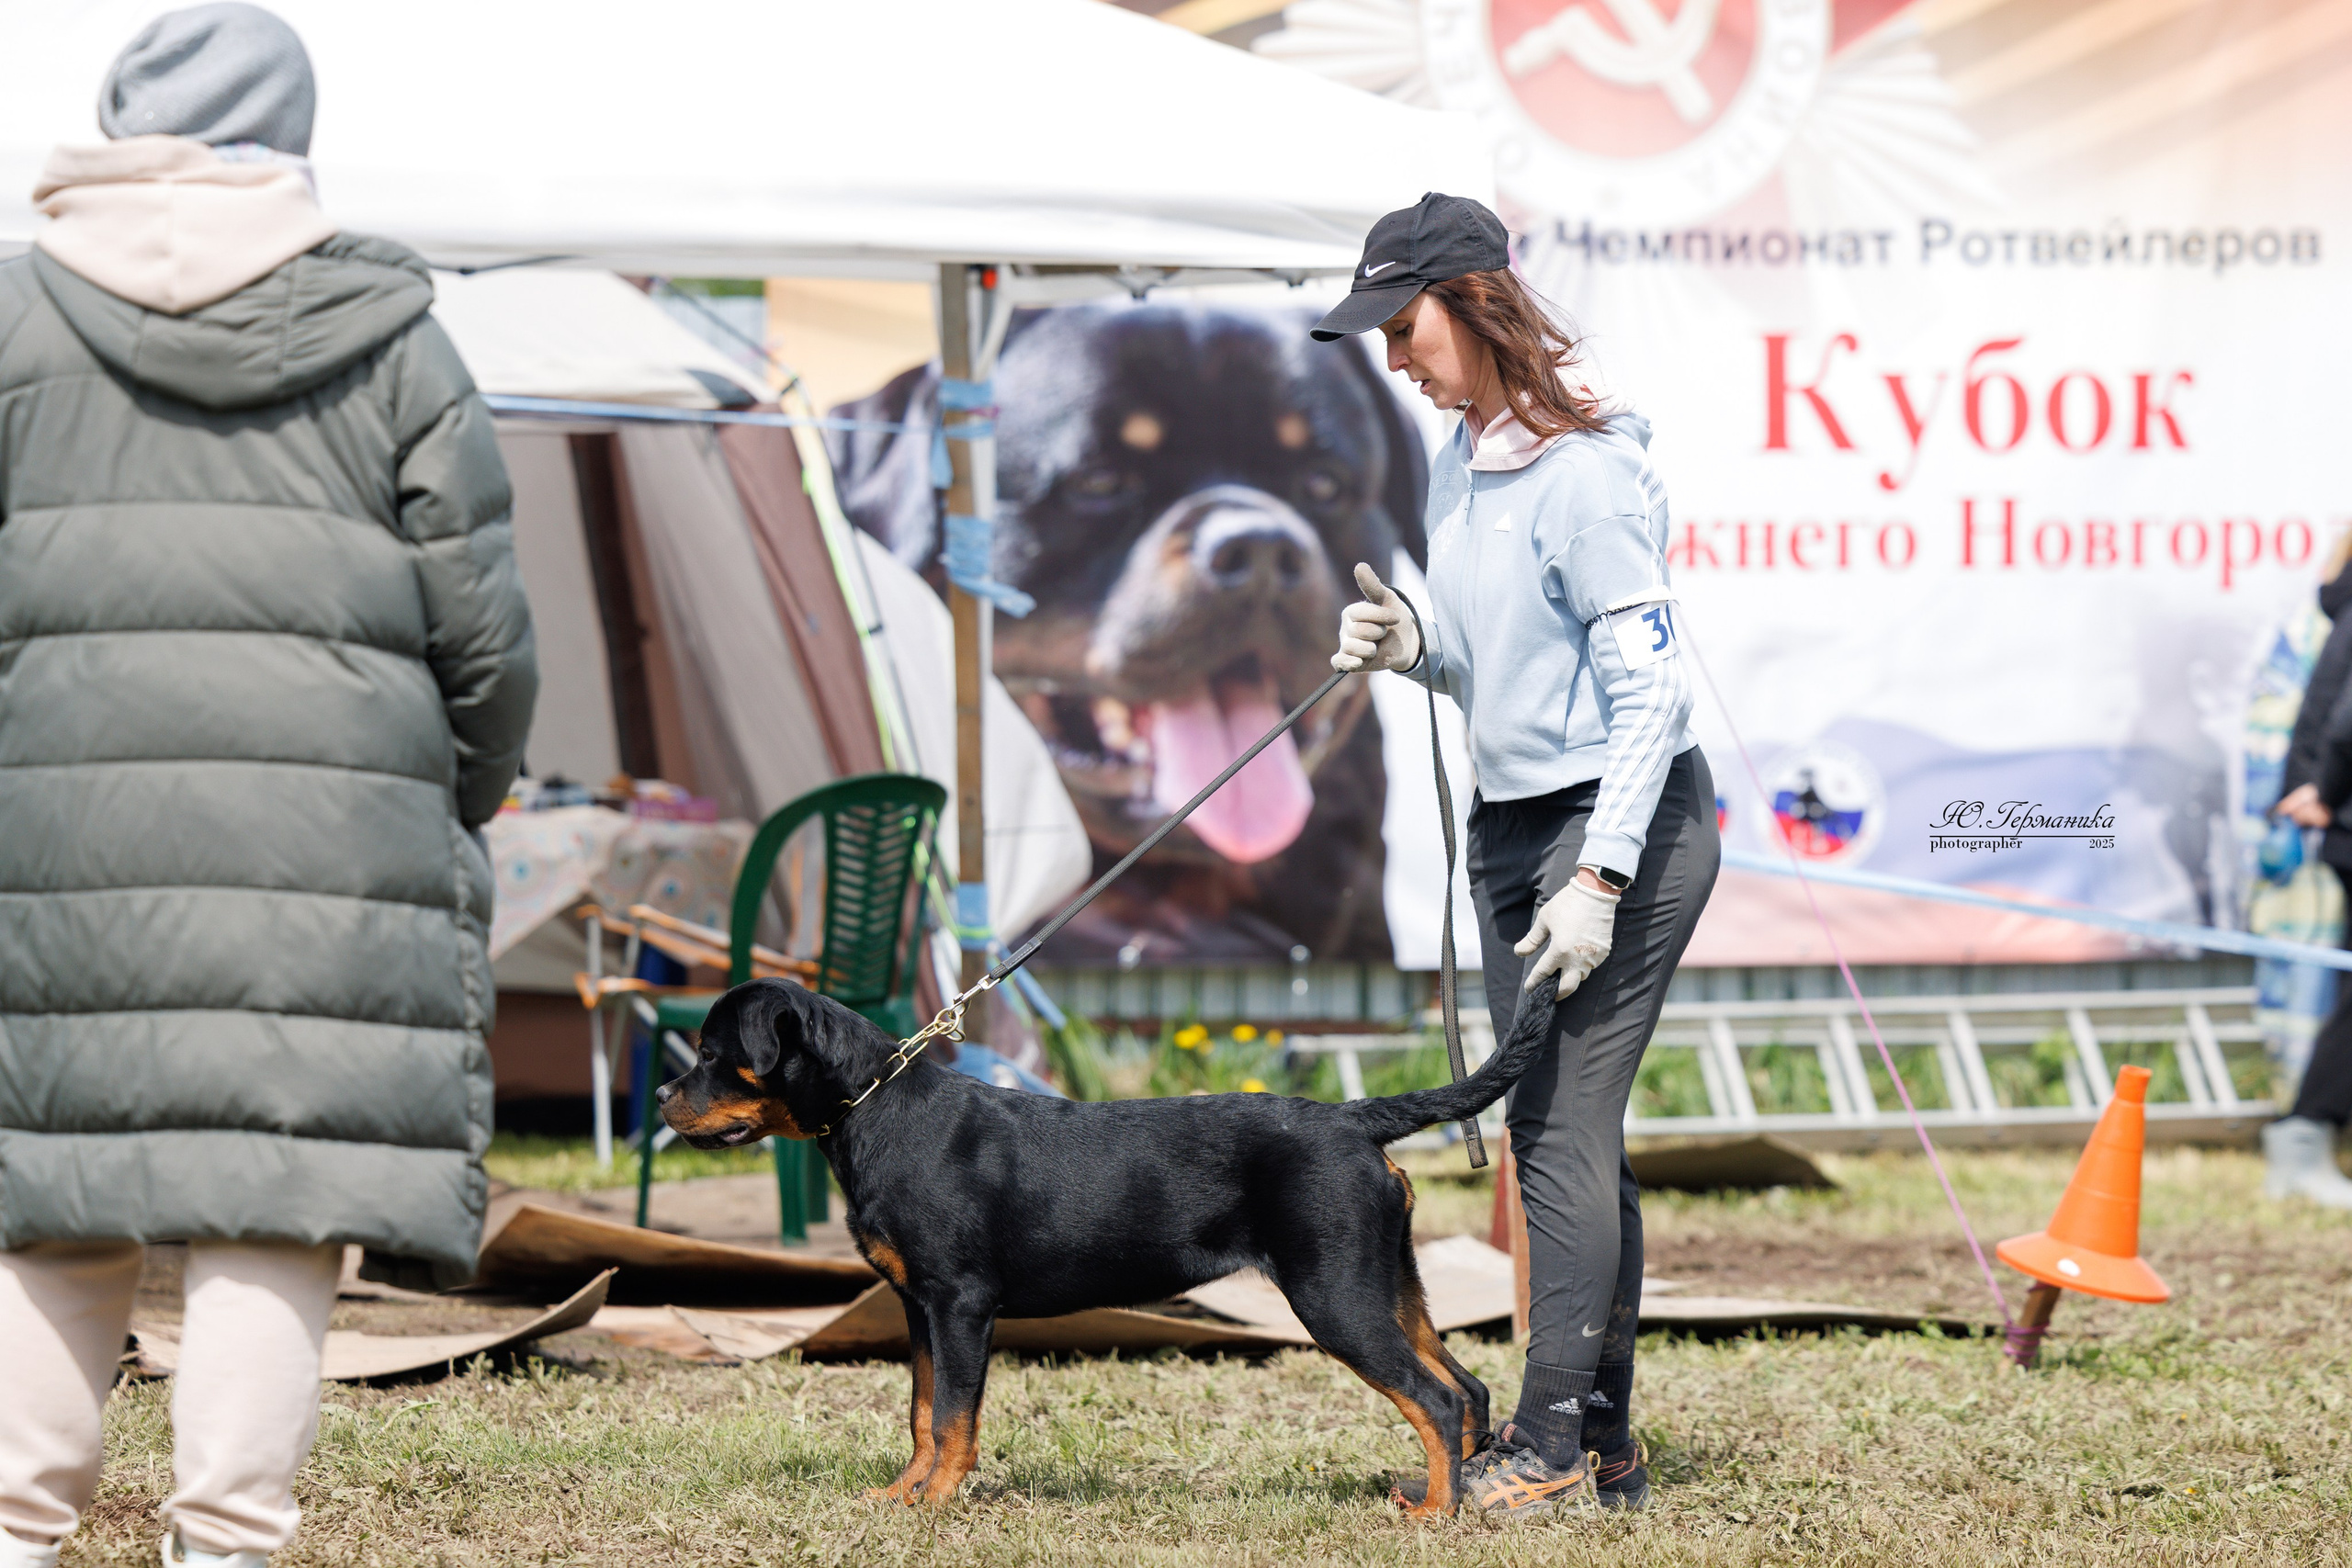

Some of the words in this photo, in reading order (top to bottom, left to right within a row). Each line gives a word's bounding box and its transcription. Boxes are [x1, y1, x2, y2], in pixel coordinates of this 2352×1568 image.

[1555, 216, 1894, 266] Чемпионат
[1918, 216, 2323, 274] Ротвейлеров
[1760, 332, 2193, 491] Кубок
[1667, 517, 1918, 570] жнего
[1959, 498, 2350, 591] Новгоро
[1549, 1404, 1582, 1416] adidas
